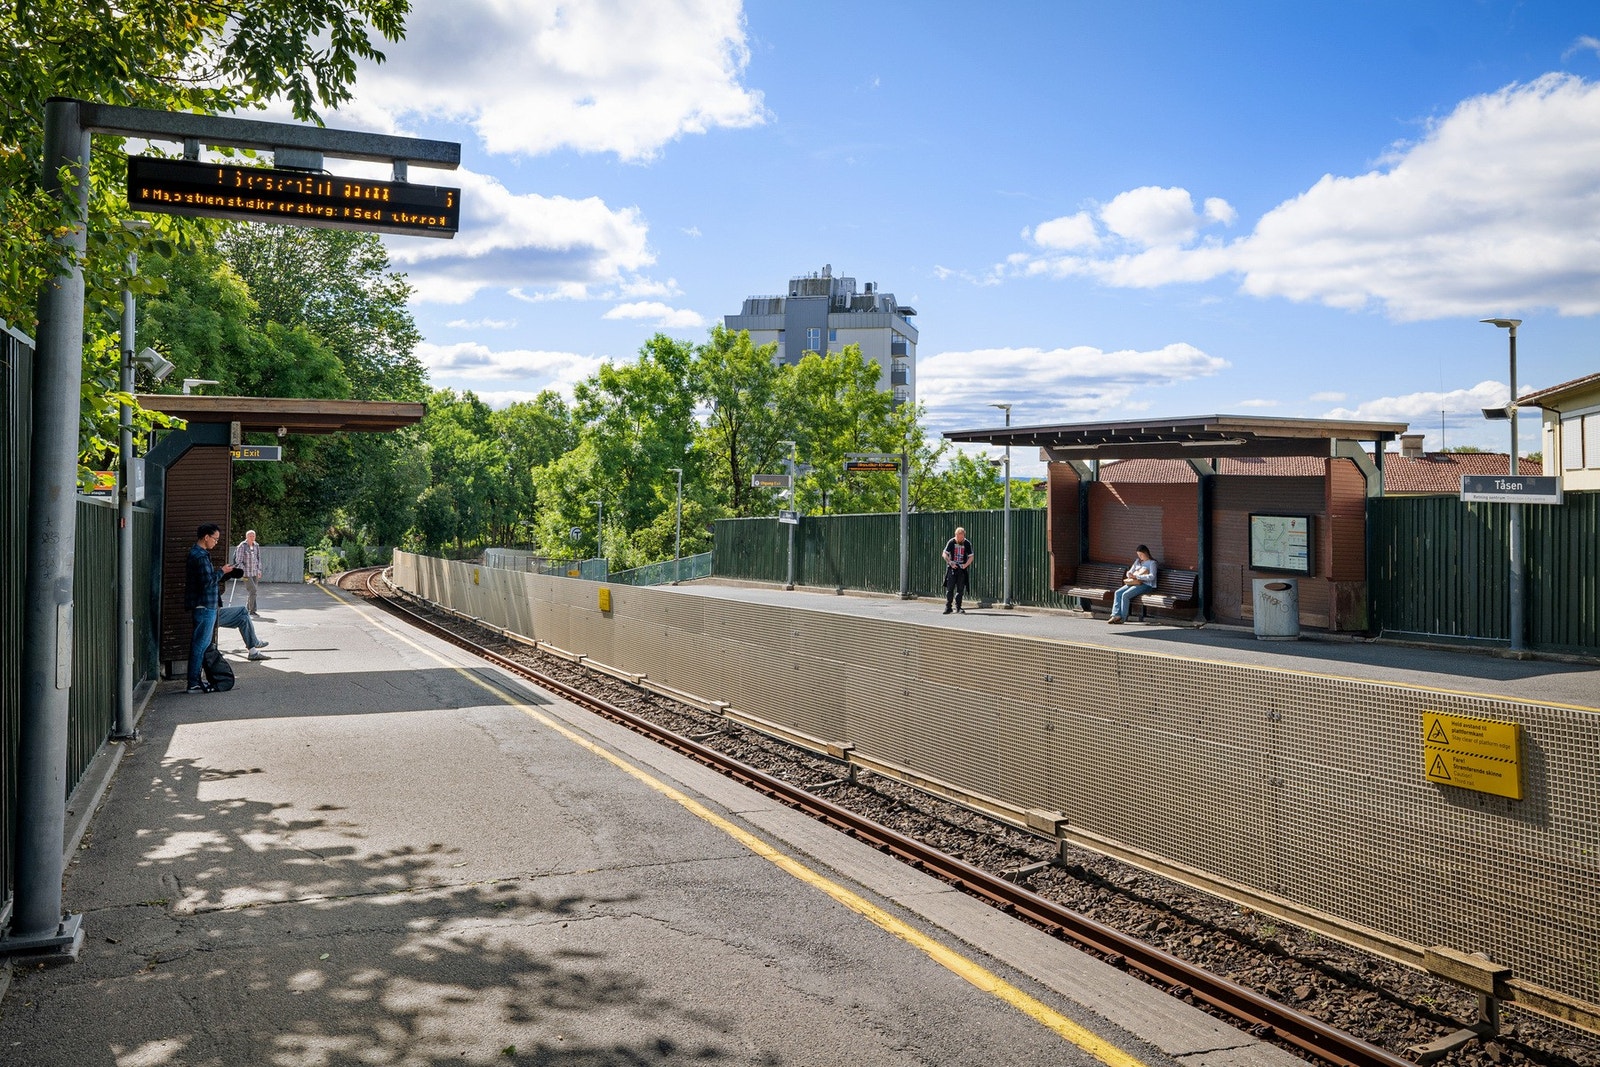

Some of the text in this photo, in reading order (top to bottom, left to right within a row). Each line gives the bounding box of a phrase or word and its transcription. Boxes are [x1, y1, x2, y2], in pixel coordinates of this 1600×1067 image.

[244, 449, 260, 457] Exit
[1494, 478, 1523, 490] Tåsen
[1452, 729, 1484, 738] plattformkant
[1479, 739, 1498, 747] platform
[1454, 771, 1473, 779] Caution!
[1486, 770, 1503, 778] skinne
